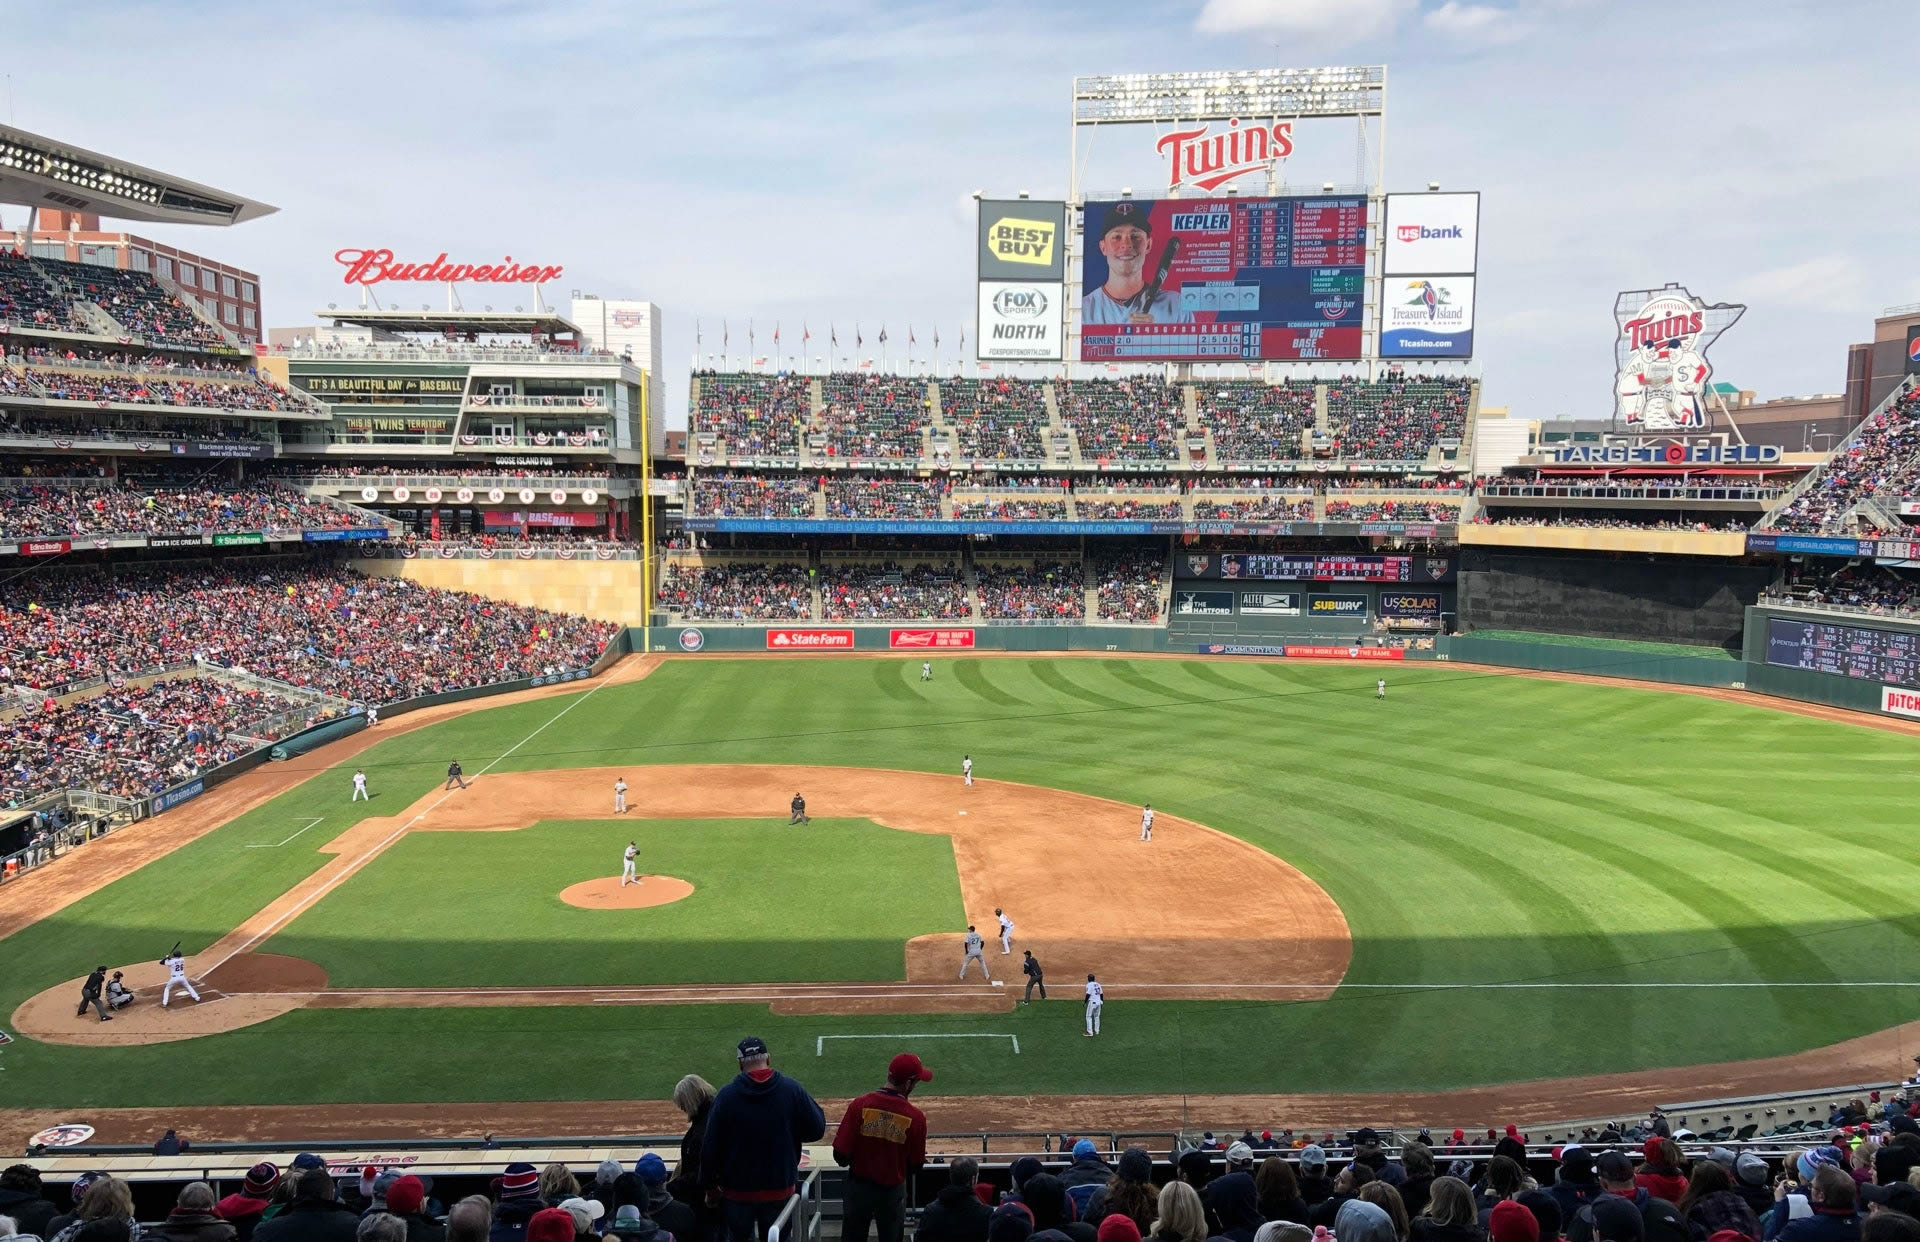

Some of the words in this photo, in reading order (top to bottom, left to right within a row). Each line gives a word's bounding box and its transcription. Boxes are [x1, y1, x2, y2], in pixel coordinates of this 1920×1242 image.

[1156, 117, 1294, 188] Twins
[1210, 204, 1230, 212] MAX
[1174, 214, 1230, 230] KEPLER
[997, 226, 1052, 244] BEST
[998, 240, 1048, 257] BUY
[334, 248, 564, 285] Budweiser
[1004, 292, 1036, 307] FOX
[1392, 307, 1427, 320] Treasure
[1437, 307, 1462, 319] Island
[993, 323, 1046, 339] NORTH
[1310, 328, 1325, 338] WE
[1624, 311, 1703, 352] Twins
[1292, 339, 1317, 348] BASE
[989, 348, 1051, 356] FOXSPORTSNORTH.COM
[1300, 348, 1322, 357] BALL
[309, 379, 327, 390] IT'S
[331, 379, 336, 390] A
[338, 378, 386, 390] BEAUTIFUL
[387, 379, 402, 390] DAY
[406, 381, 416, 390] for
[419, 379, 462, 391] BASEBALL
[347, 419, 363, 428] THIS
[364, 419, 372, 428] IS
[374, 418, 405, 431] TWINS
[407, 419, 447, 428] TERRITORY
[1558, 446, 1662, 462] TARGET
[1692, 446, 1781, 462] FIELD
[496, 457, 515, 465] GOOSE
[516, 457, 539, 465] ISLAND
[540, 457, 553, 466] PUB
[763, 523, 792, 531] HELPS
[794, 523, 826, 531] TARGET
[884, 524, 918, 532] MILLION
[1059, 525, 1144, 533] PENTAIR.COM/TWINS
[1793, 542, 1856, 551] PENTAIR.COM/TWINS
[1243, 594, 1263, 603] ALTEC
[1313, 601, 1360, 610] SUBWAY
[1800, 660, 1815, 669] N.L.
